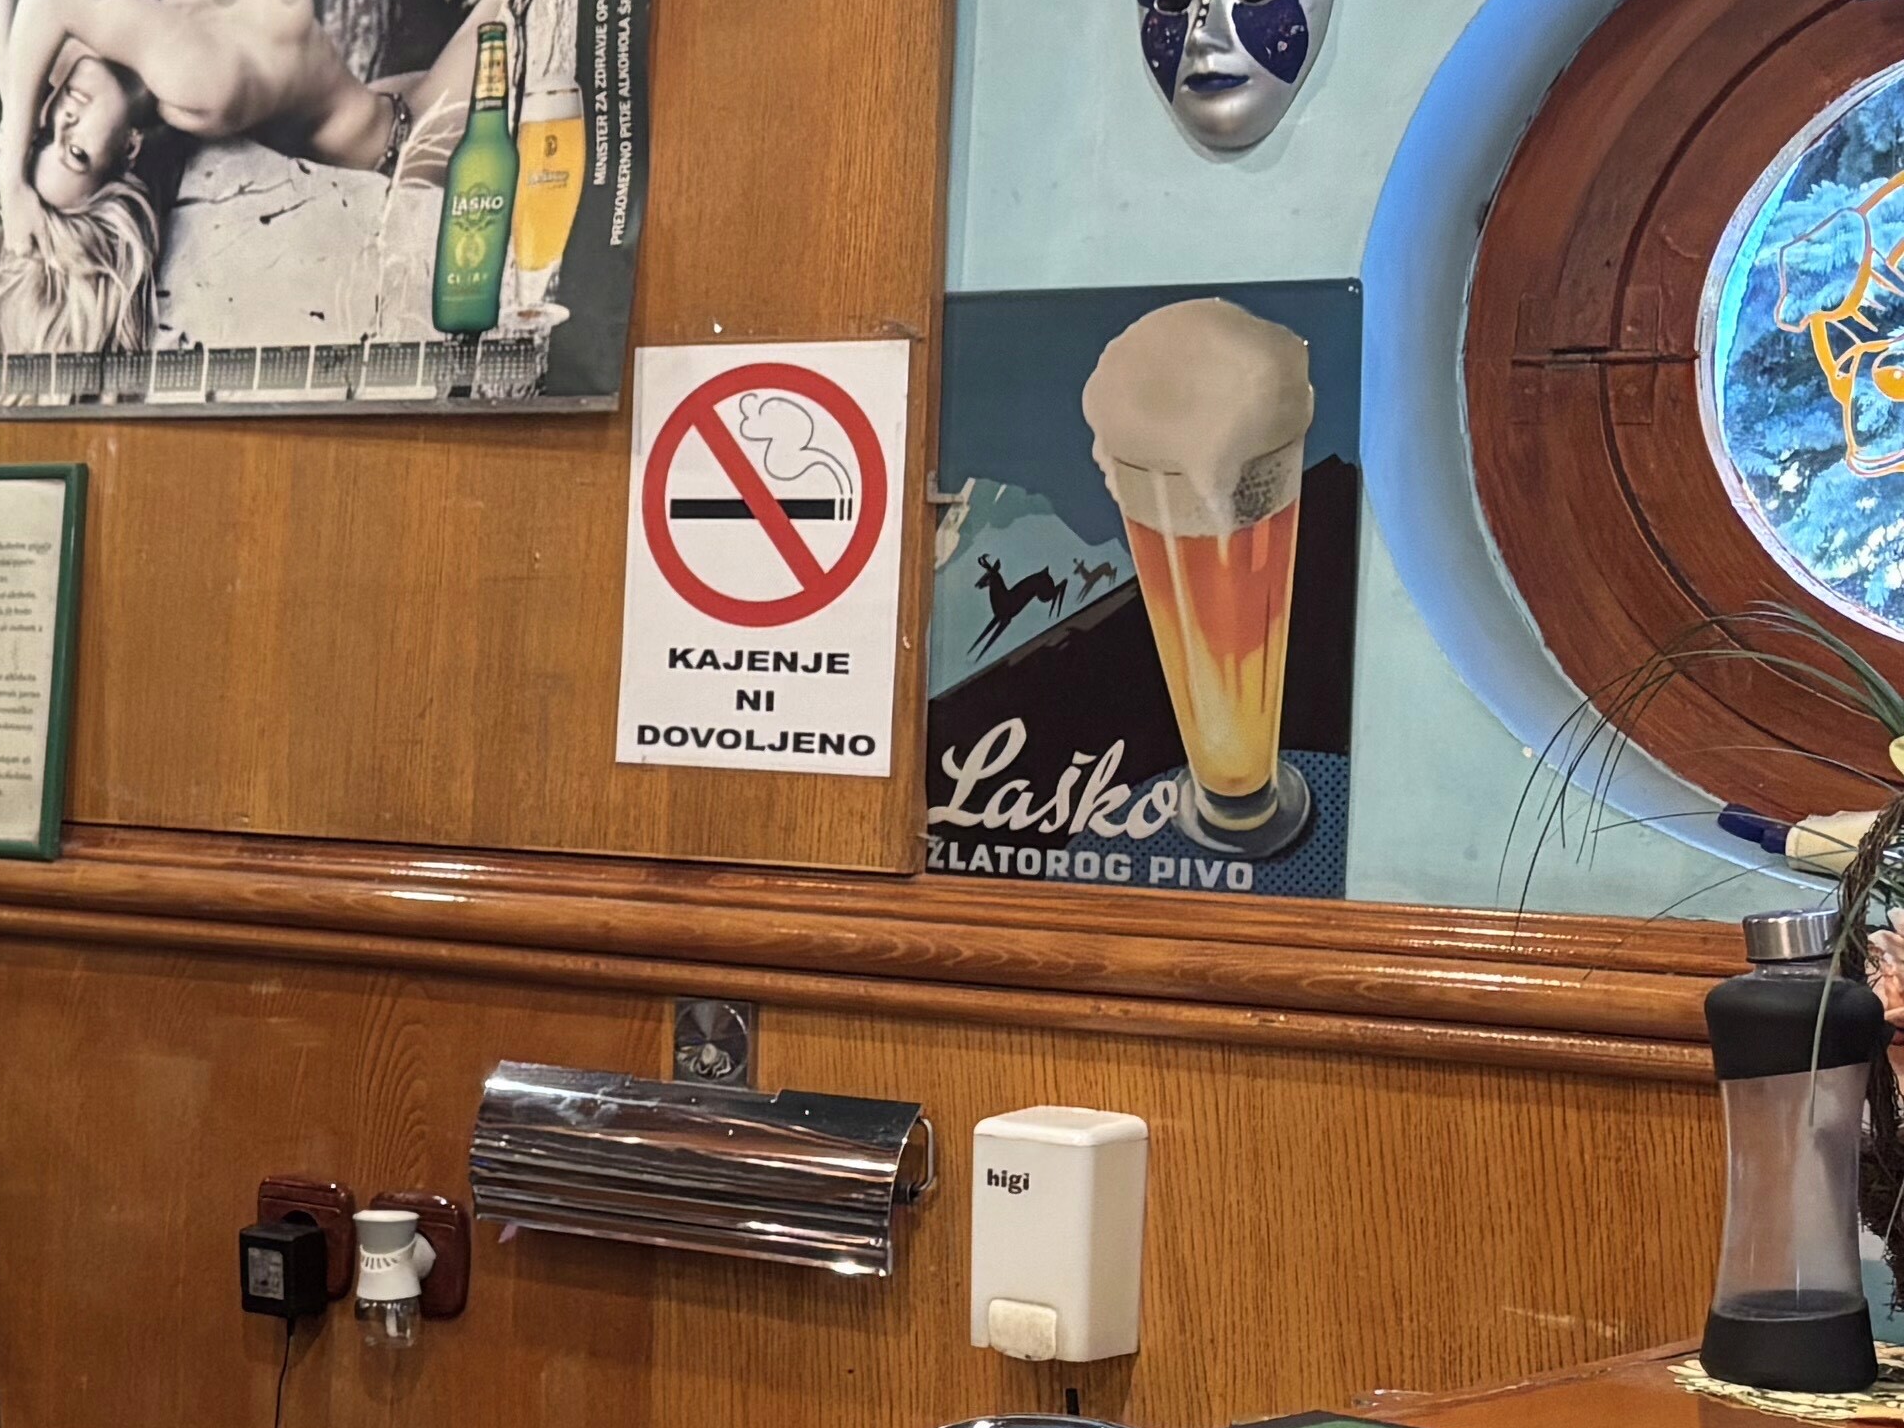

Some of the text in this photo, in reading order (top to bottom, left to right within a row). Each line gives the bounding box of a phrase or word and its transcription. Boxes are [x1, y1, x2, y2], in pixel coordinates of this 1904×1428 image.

[594, 24, 609, 89] ZDRAVJE
[617, 17, 632, 98] ALKOHOLA
[595, 91, 608, 112] ZA
[617, 99, 632, 139] PITJE
[593, 115, 610, 186] MINISTER
[609, 141, 633, 247] PREKOMERNO
[666, 646, 851, 676] KAJENJE
[734, 690, 775, 713] NI
[635, 724, 877, 758] DOVOLJENO
[927, 716, 1183, 840] Laško
[926, 840, 1255, 892] ZLATOROG PIVO
[986, 1167, 1030, 1194] higi
